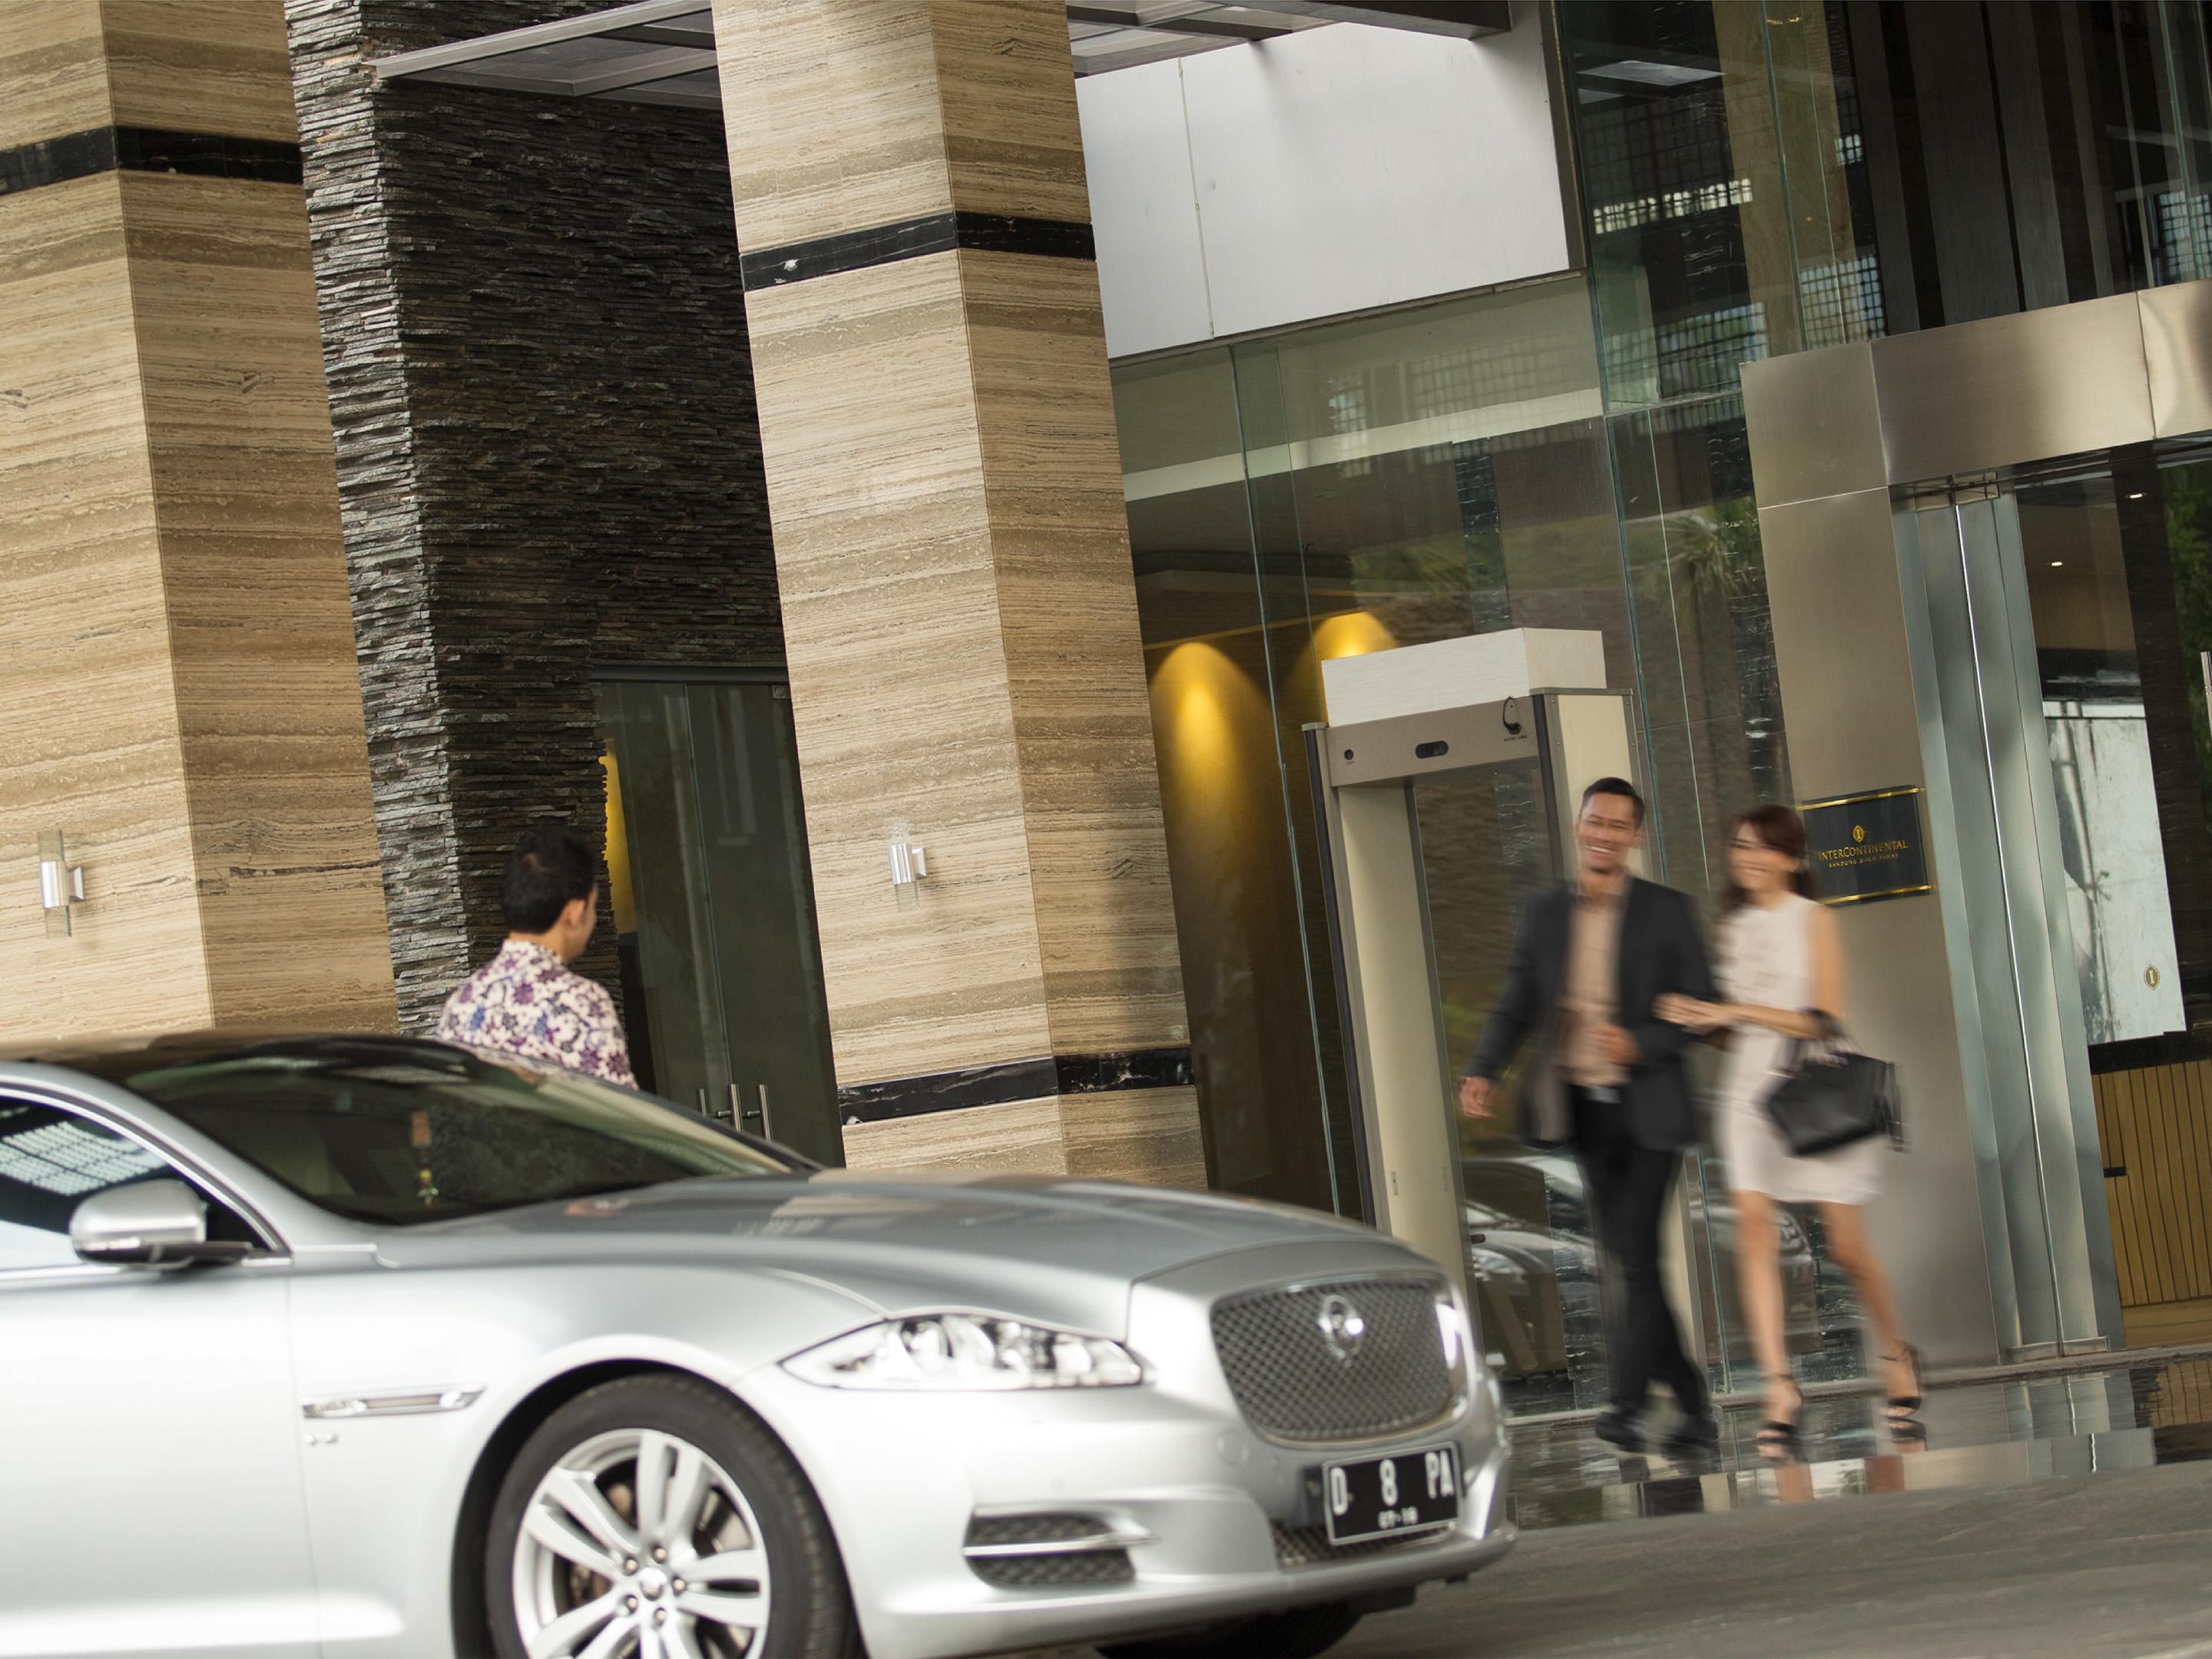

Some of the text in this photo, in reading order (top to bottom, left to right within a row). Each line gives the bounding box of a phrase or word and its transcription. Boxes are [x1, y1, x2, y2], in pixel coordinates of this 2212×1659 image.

[1331, 1451, 1454, 1515] D 8 PA
